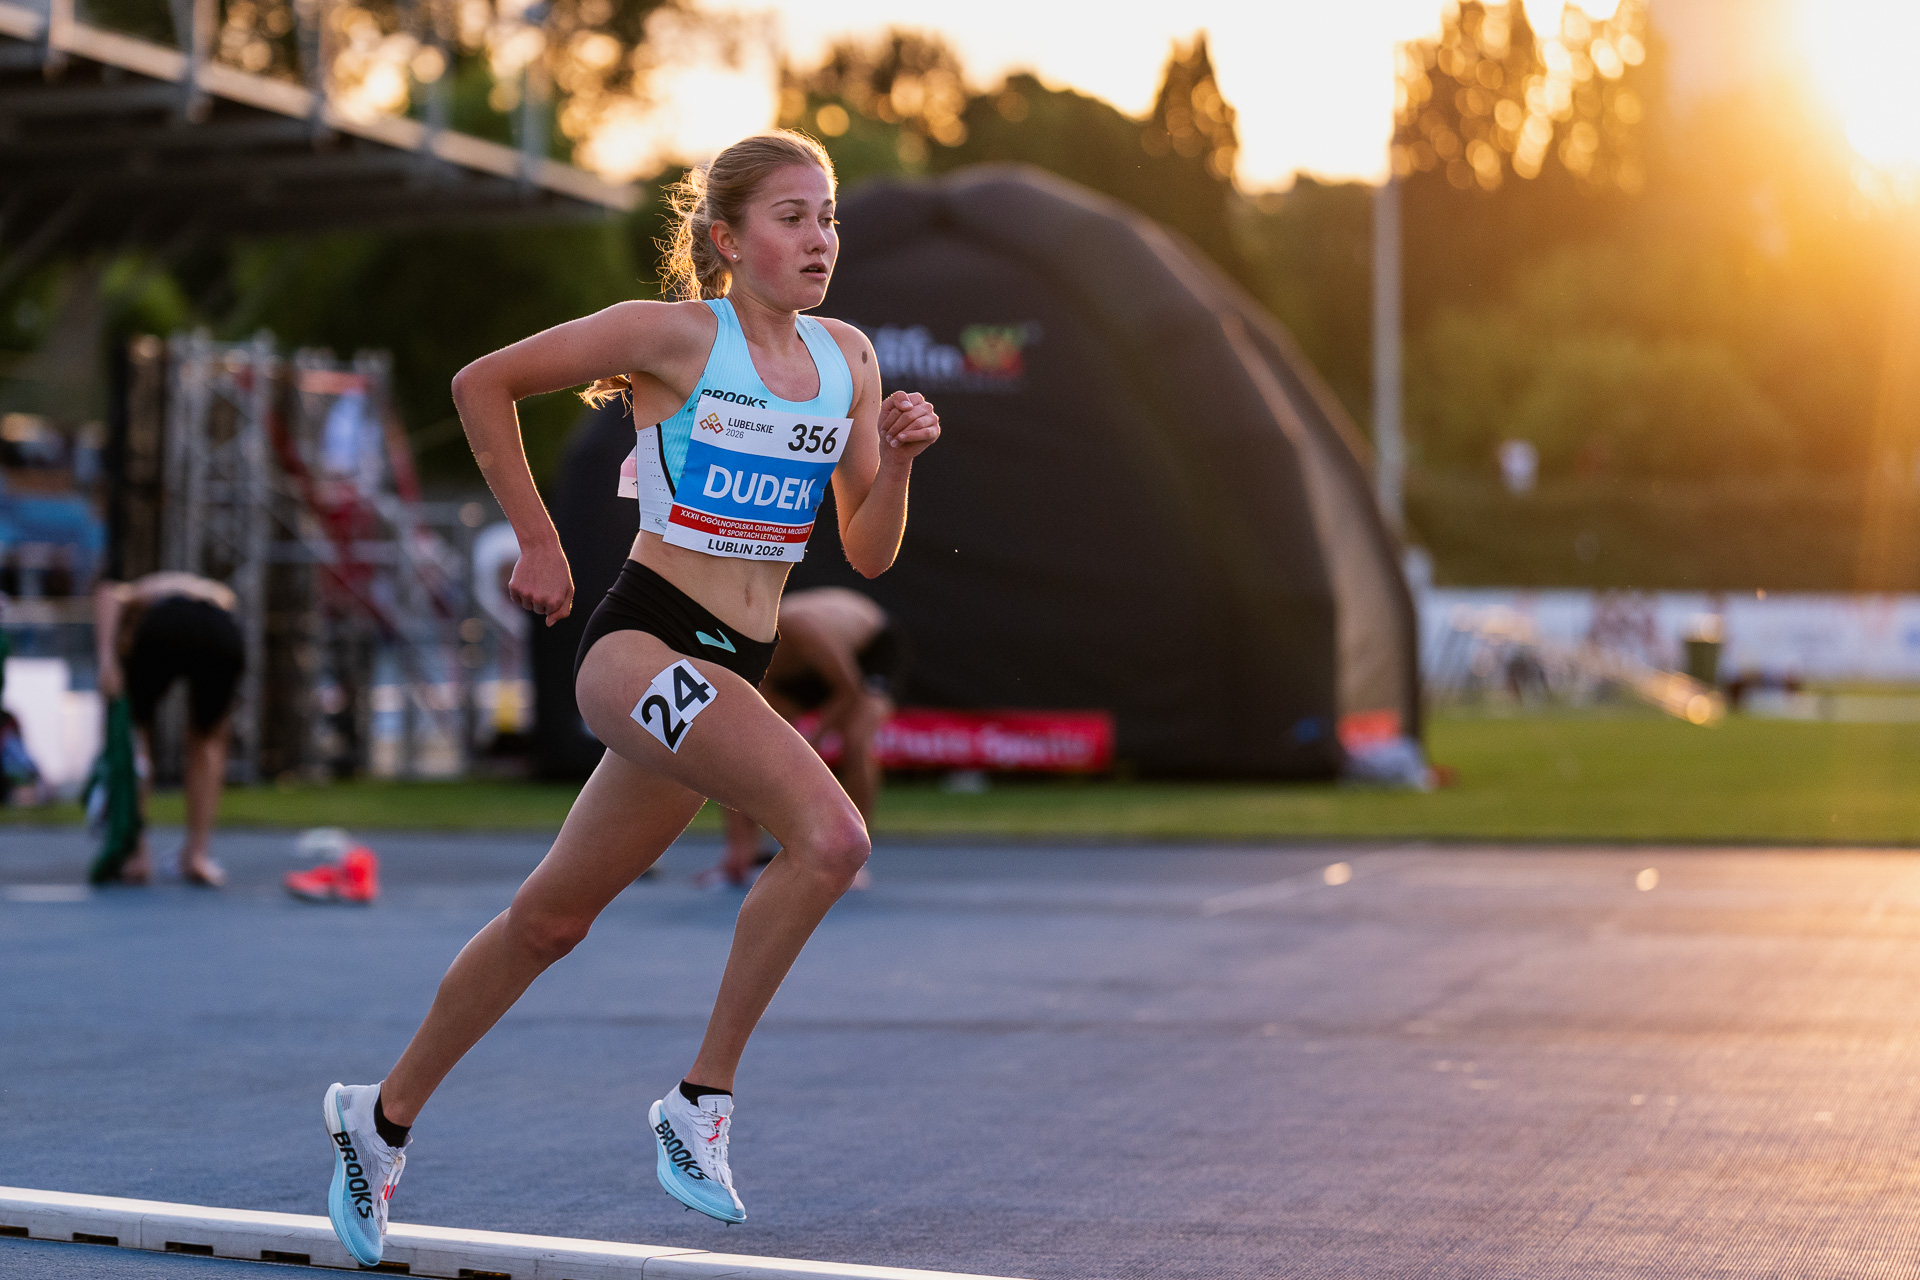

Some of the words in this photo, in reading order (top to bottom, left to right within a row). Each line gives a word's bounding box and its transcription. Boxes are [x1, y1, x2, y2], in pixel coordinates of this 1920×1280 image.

[725, 428, 745, 439] 2026
[727, 417, 774, 434] LUBELSKIE
[787, 423, 839, 455] 356
[702, 463, 817, 511] DUDEK
[680, 509, 700, 521] XXXII
[700, 515, 754, 531] OGÓLNOPOLSKA
[754, 525, 787, 534] OLIMPIADA
[727, 528, 760, 540] SPORTACH
[760, 533, 786, 542] LETNICH
[707, 538, 754, 555] LUBLIN
[754, 544, 785, 557] 2026
[641, 664, 711, 751] 24
[654, 1119, 712, 1181] BROOKS
[332, 1130, 375, 1220] BROOKS
